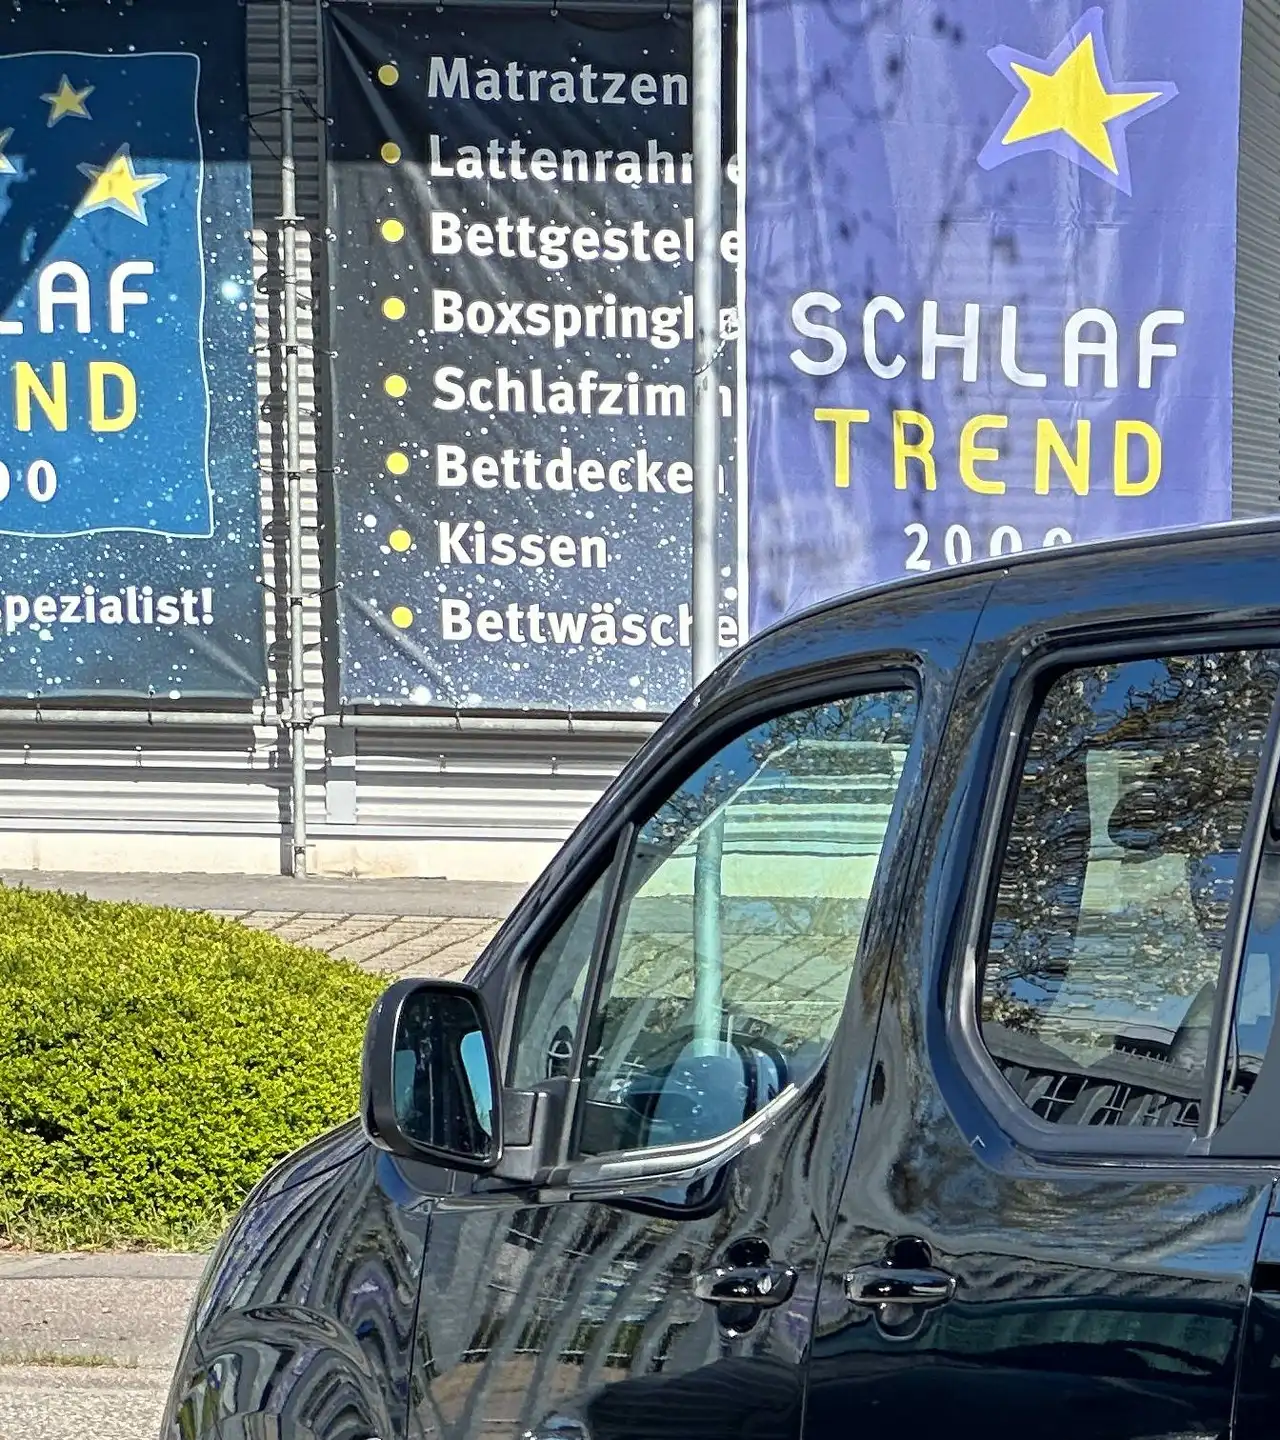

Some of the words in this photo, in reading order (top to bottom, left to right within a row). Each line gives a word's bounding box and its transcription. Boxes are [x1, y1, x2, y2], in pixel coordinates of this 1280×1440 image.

[428, 57, 687, 105] Matratzen
[432, 212, 739, 269] Bettgestele
[791, 292, 1185, 389] SCHLAF
[434, 367, 732, 417] Schlafzim
[437, 445, 725, 494] Bettdecke
[816, 409, 1160, 495] TREND
[440, 522, 606, 568] Kissen
[0, 586, 213, 636] pezialist!
